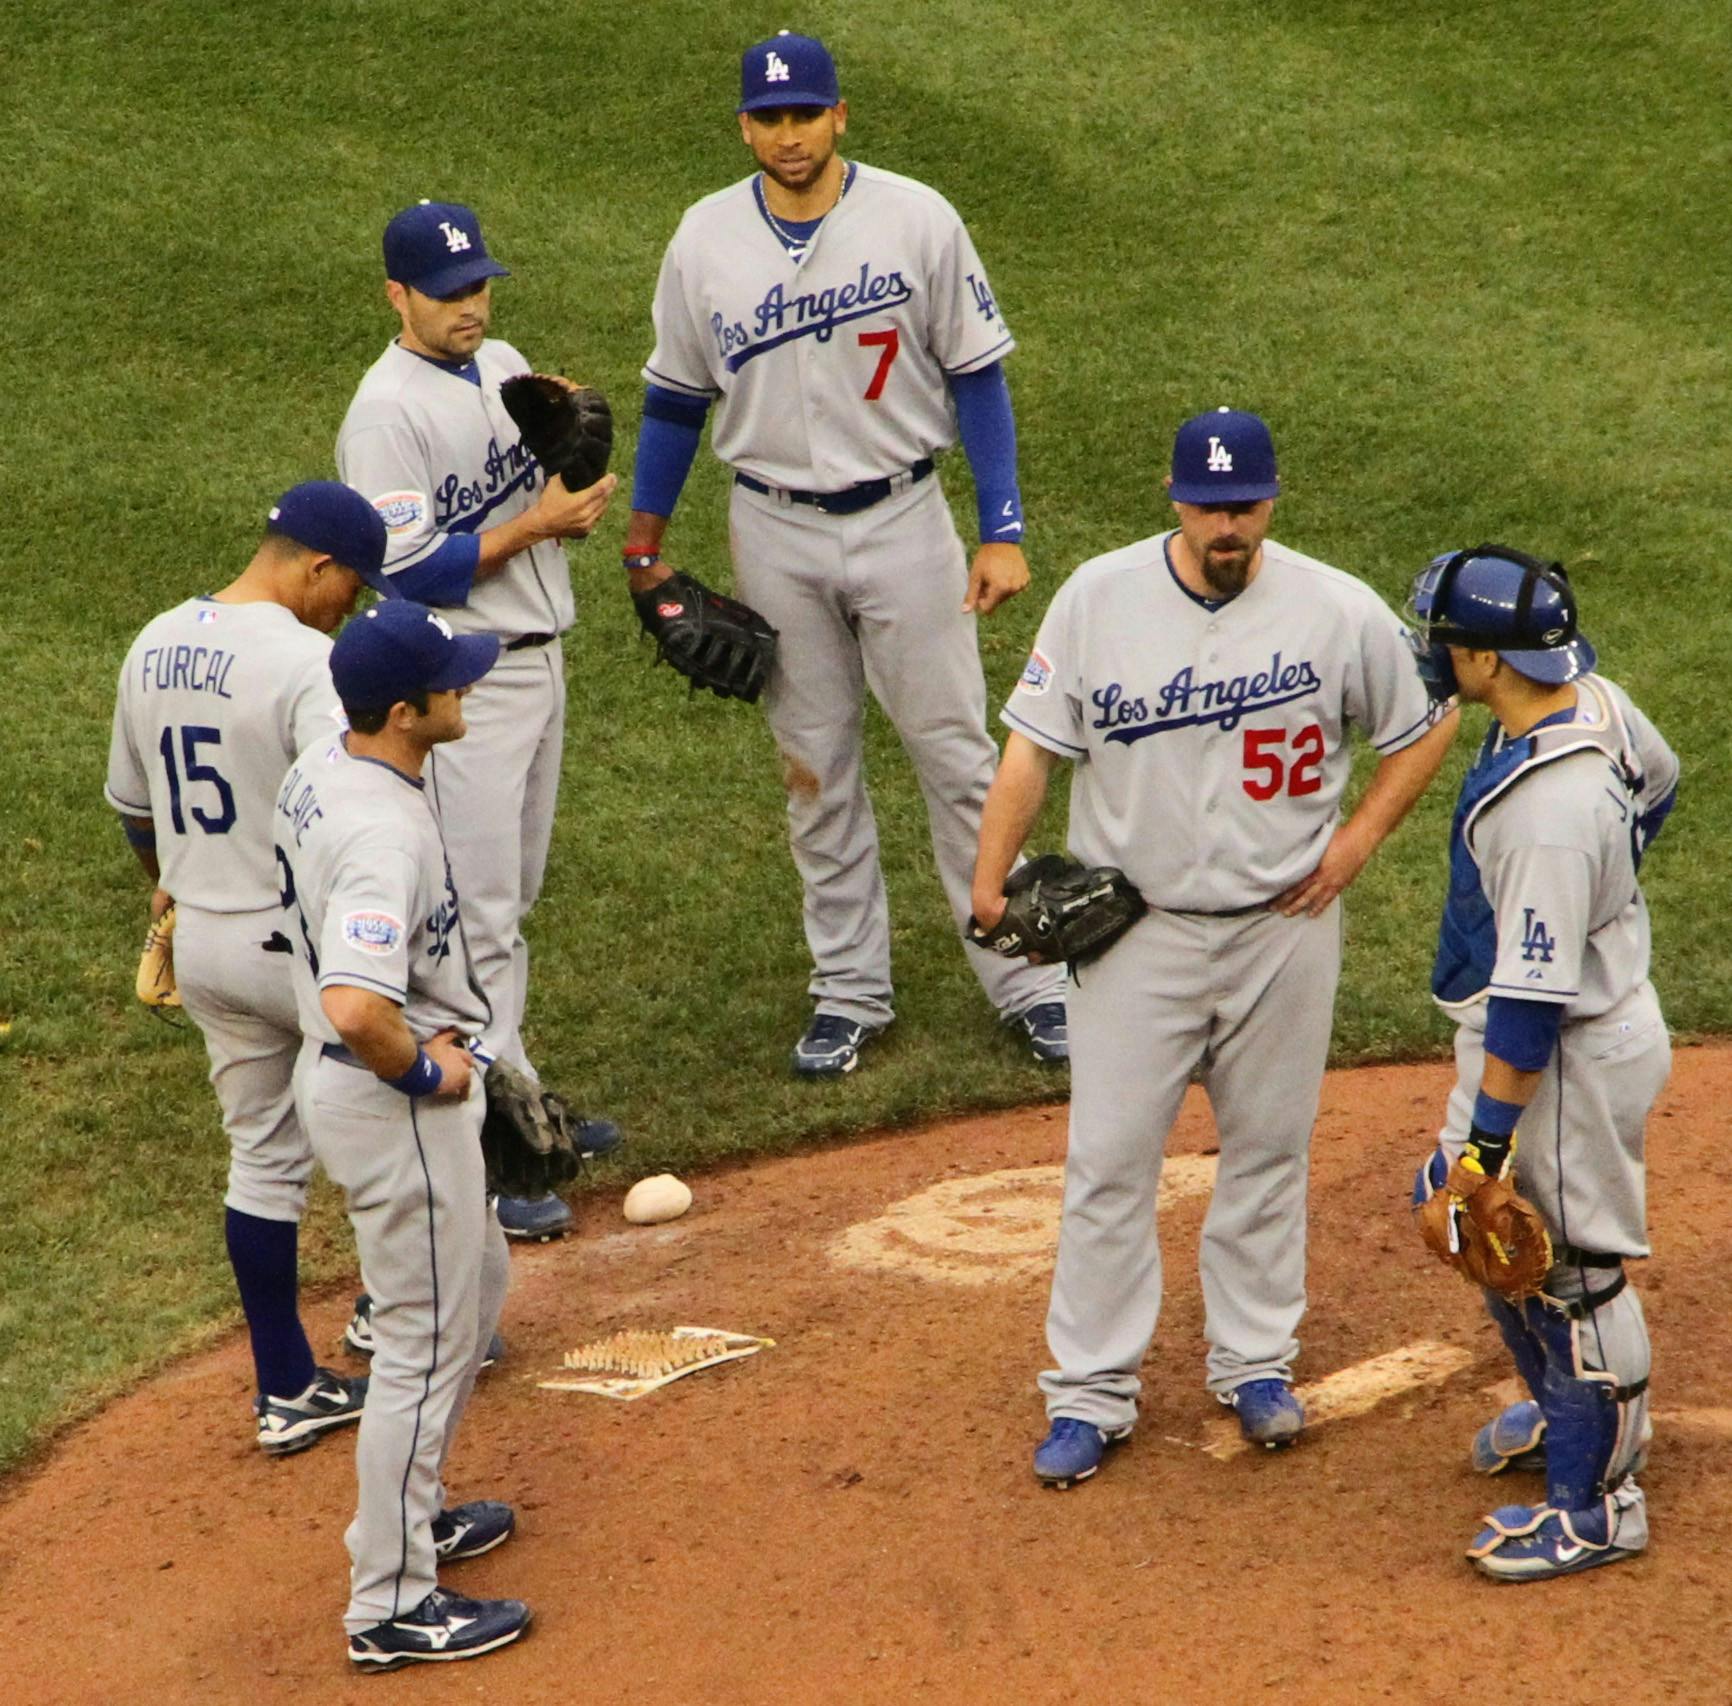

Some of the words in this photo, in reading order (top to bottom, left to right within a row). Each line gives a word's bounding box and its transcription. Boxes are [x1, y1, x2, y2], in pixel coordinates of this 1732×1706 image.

[765, 51, 790, 82] LA
[438, 221, 472, 253] LA
[711, 311, 748, 358] Los
[754, 262, 909, 344] Angeles
[858, 327, 900, 401] 7
[1207, 436, 1233, 472] LA
[435, 473, 484, 527] Los
[143, 645, 235, 699] FURCAL
[1092, 683, 1148, 729] Los
[1155, 651, 1321, 732] Angeles
[160, 725, 237, 835] 15
[1242, 723, 1325, 802] 52
[1521, 907, 1555, 963] LA
